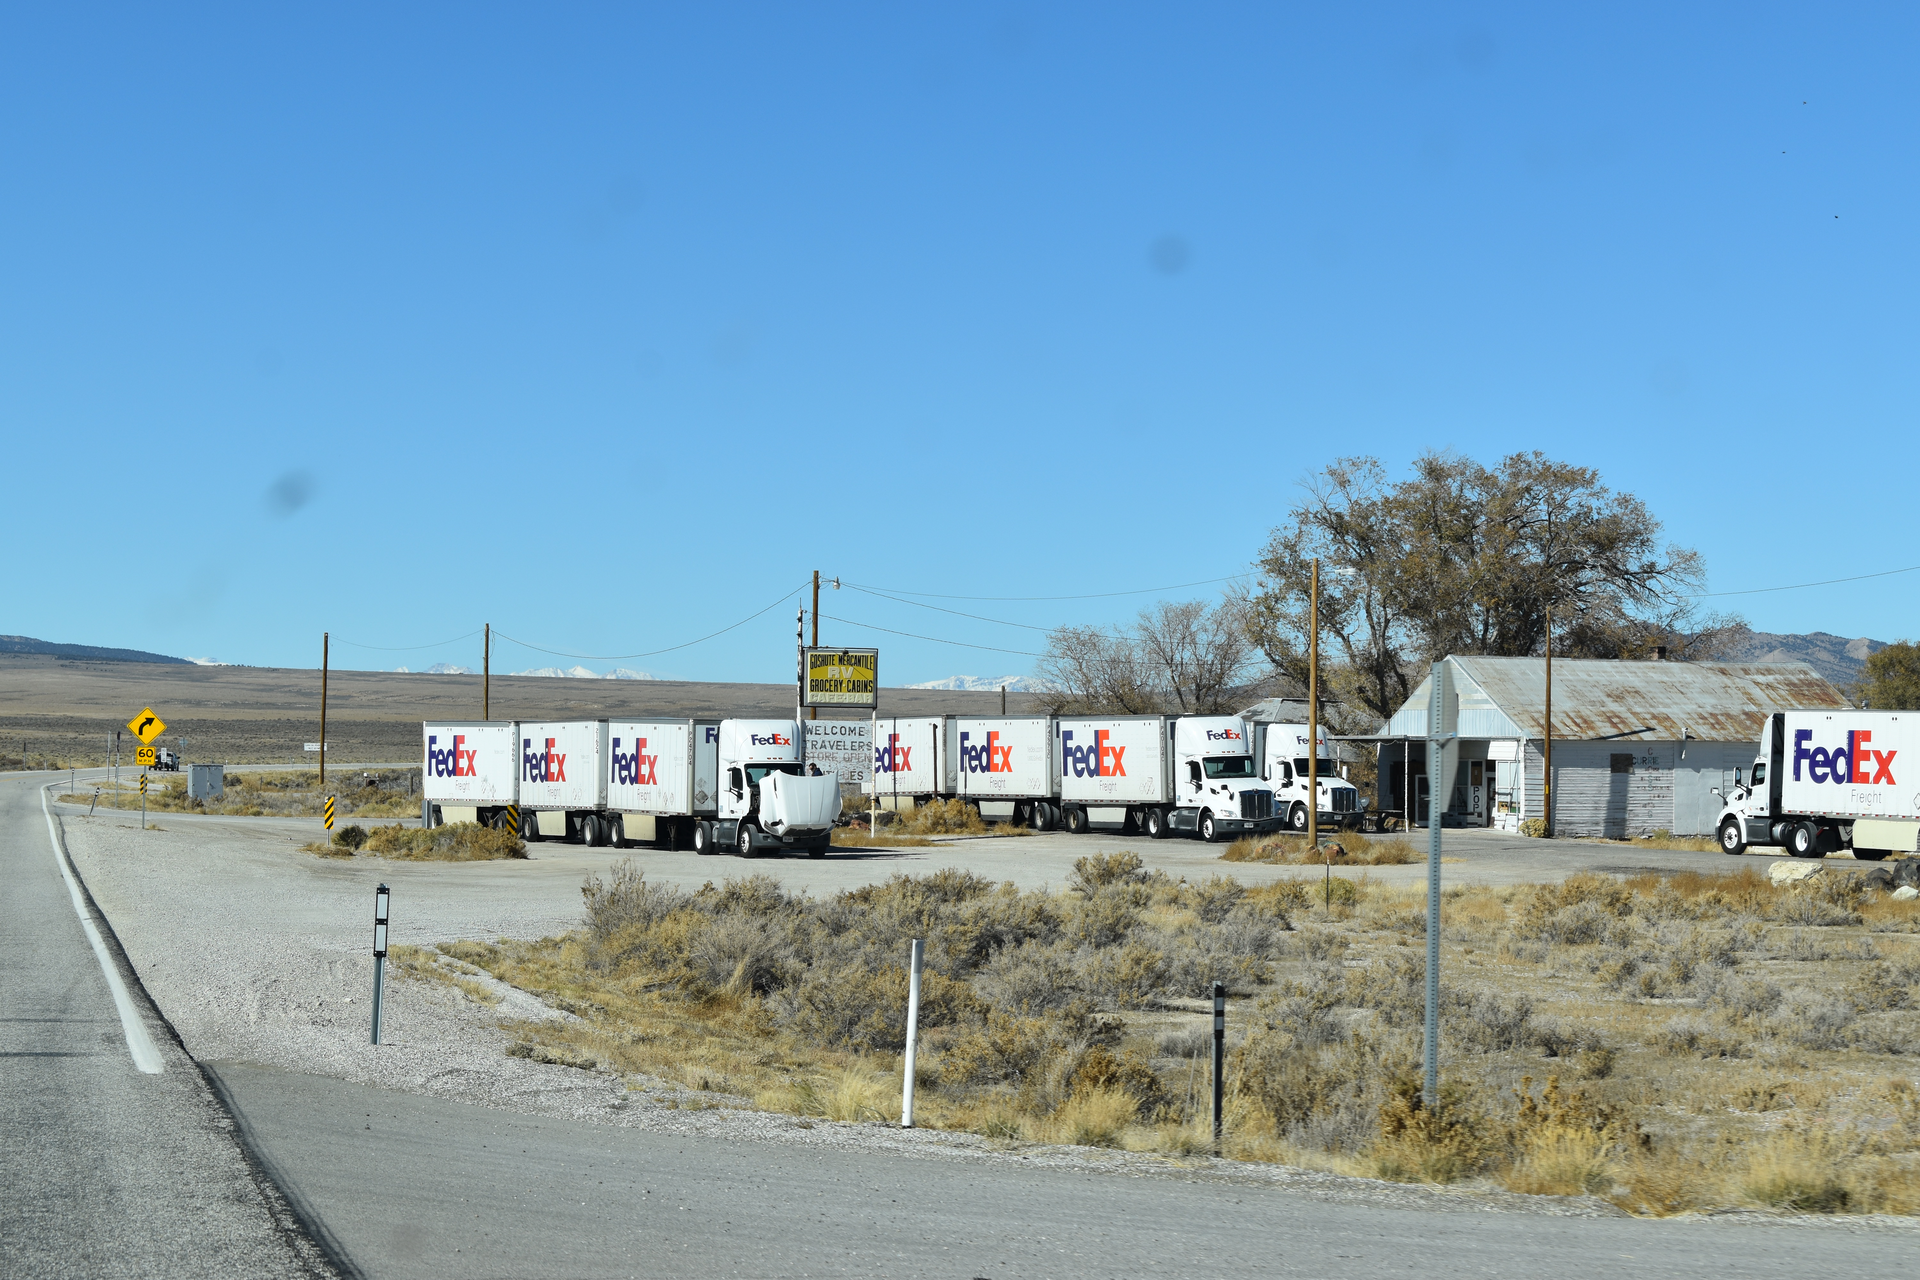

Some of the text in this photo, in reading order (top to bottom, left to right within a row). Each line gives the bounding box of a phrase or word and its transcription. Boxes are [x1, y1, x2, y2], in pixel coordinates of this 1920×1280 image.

[810, 653, 874, 670] GOSHUTE MERCANTILE
[828, 667, 854, 679] RV
[810, 679, 873, 692] GROCERY CABINS
[806, 725, 865, 736] WELCOME
[1206, 729, 1241, 741] FedEx
[751, 734, 791, 746] FedEx
[138, 748, 154, 758] 60
[428, 735, 477, 778] FedEx
[523, 738, 566, 783] FedEx
[875, 733, 912, 774] edEx
[960, 731, 1013, 774] FedEx
[1062, 729, 1127, 778] FedEx
[1632, 756, 1660, 766] CURRIE
[1795, 729, 1898, 785] FedEx
[611, 737, 658, 786] FedEx
[1851, 789, 1882, 807] Freight
